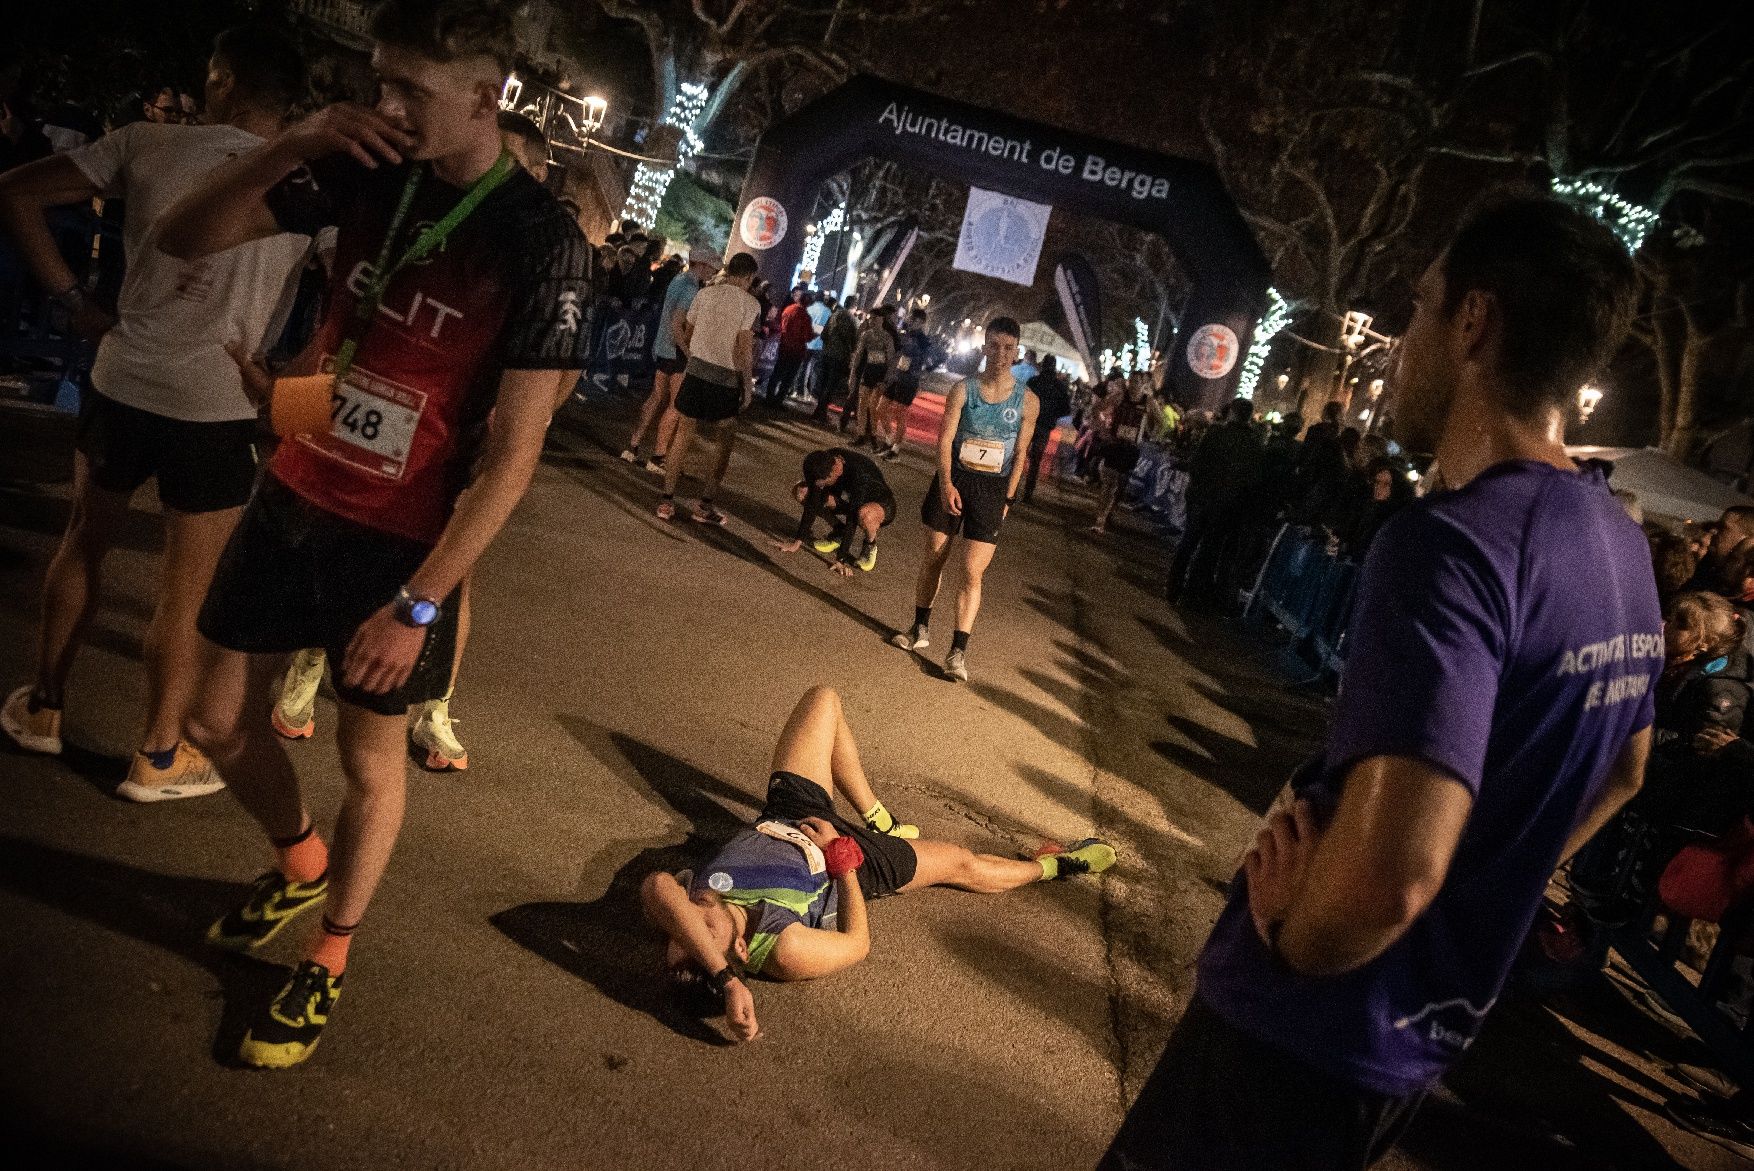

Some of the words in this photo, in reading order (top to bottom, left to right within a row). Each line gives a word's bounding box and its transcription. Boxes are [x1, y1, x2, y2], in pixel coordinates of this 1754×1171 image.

[878, 101, 1031, 164] Ajuntament
[1039, 146, 1076, 175] de
[1082, 154, 1171, 201] Berga
[979, 448, 988, 461] 7
